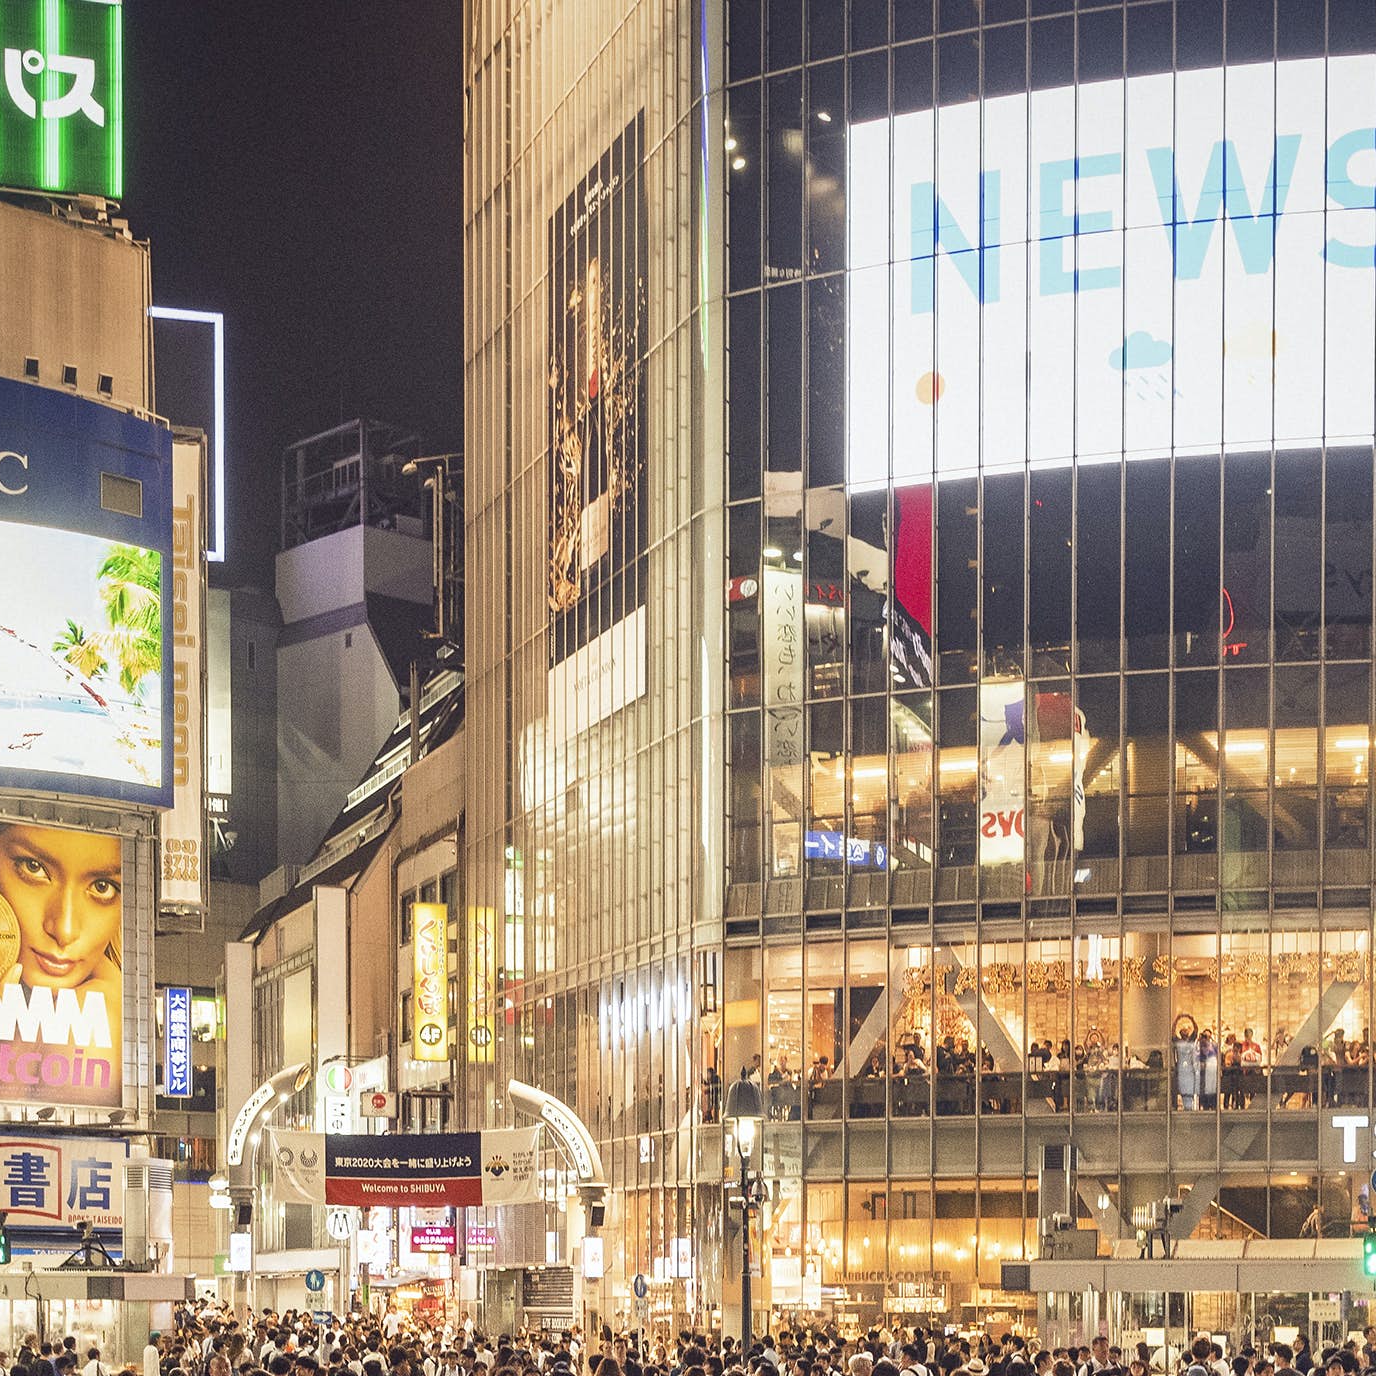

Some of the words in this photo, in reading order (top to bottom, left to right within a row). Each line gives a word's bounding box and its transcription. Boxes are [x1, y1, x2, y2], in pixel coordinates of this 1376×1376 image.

[902, 953, 1178, 997] STARBUCKS
[420, 1025, 442, 1043] 4F
[361, 1183, 399, 1194] Welcome
[400, 1183, 409, 1194] to
[410, 1183, 446, 1194] SHIBUYA
[93, 1215, 123, 1226] TAISEIDO
